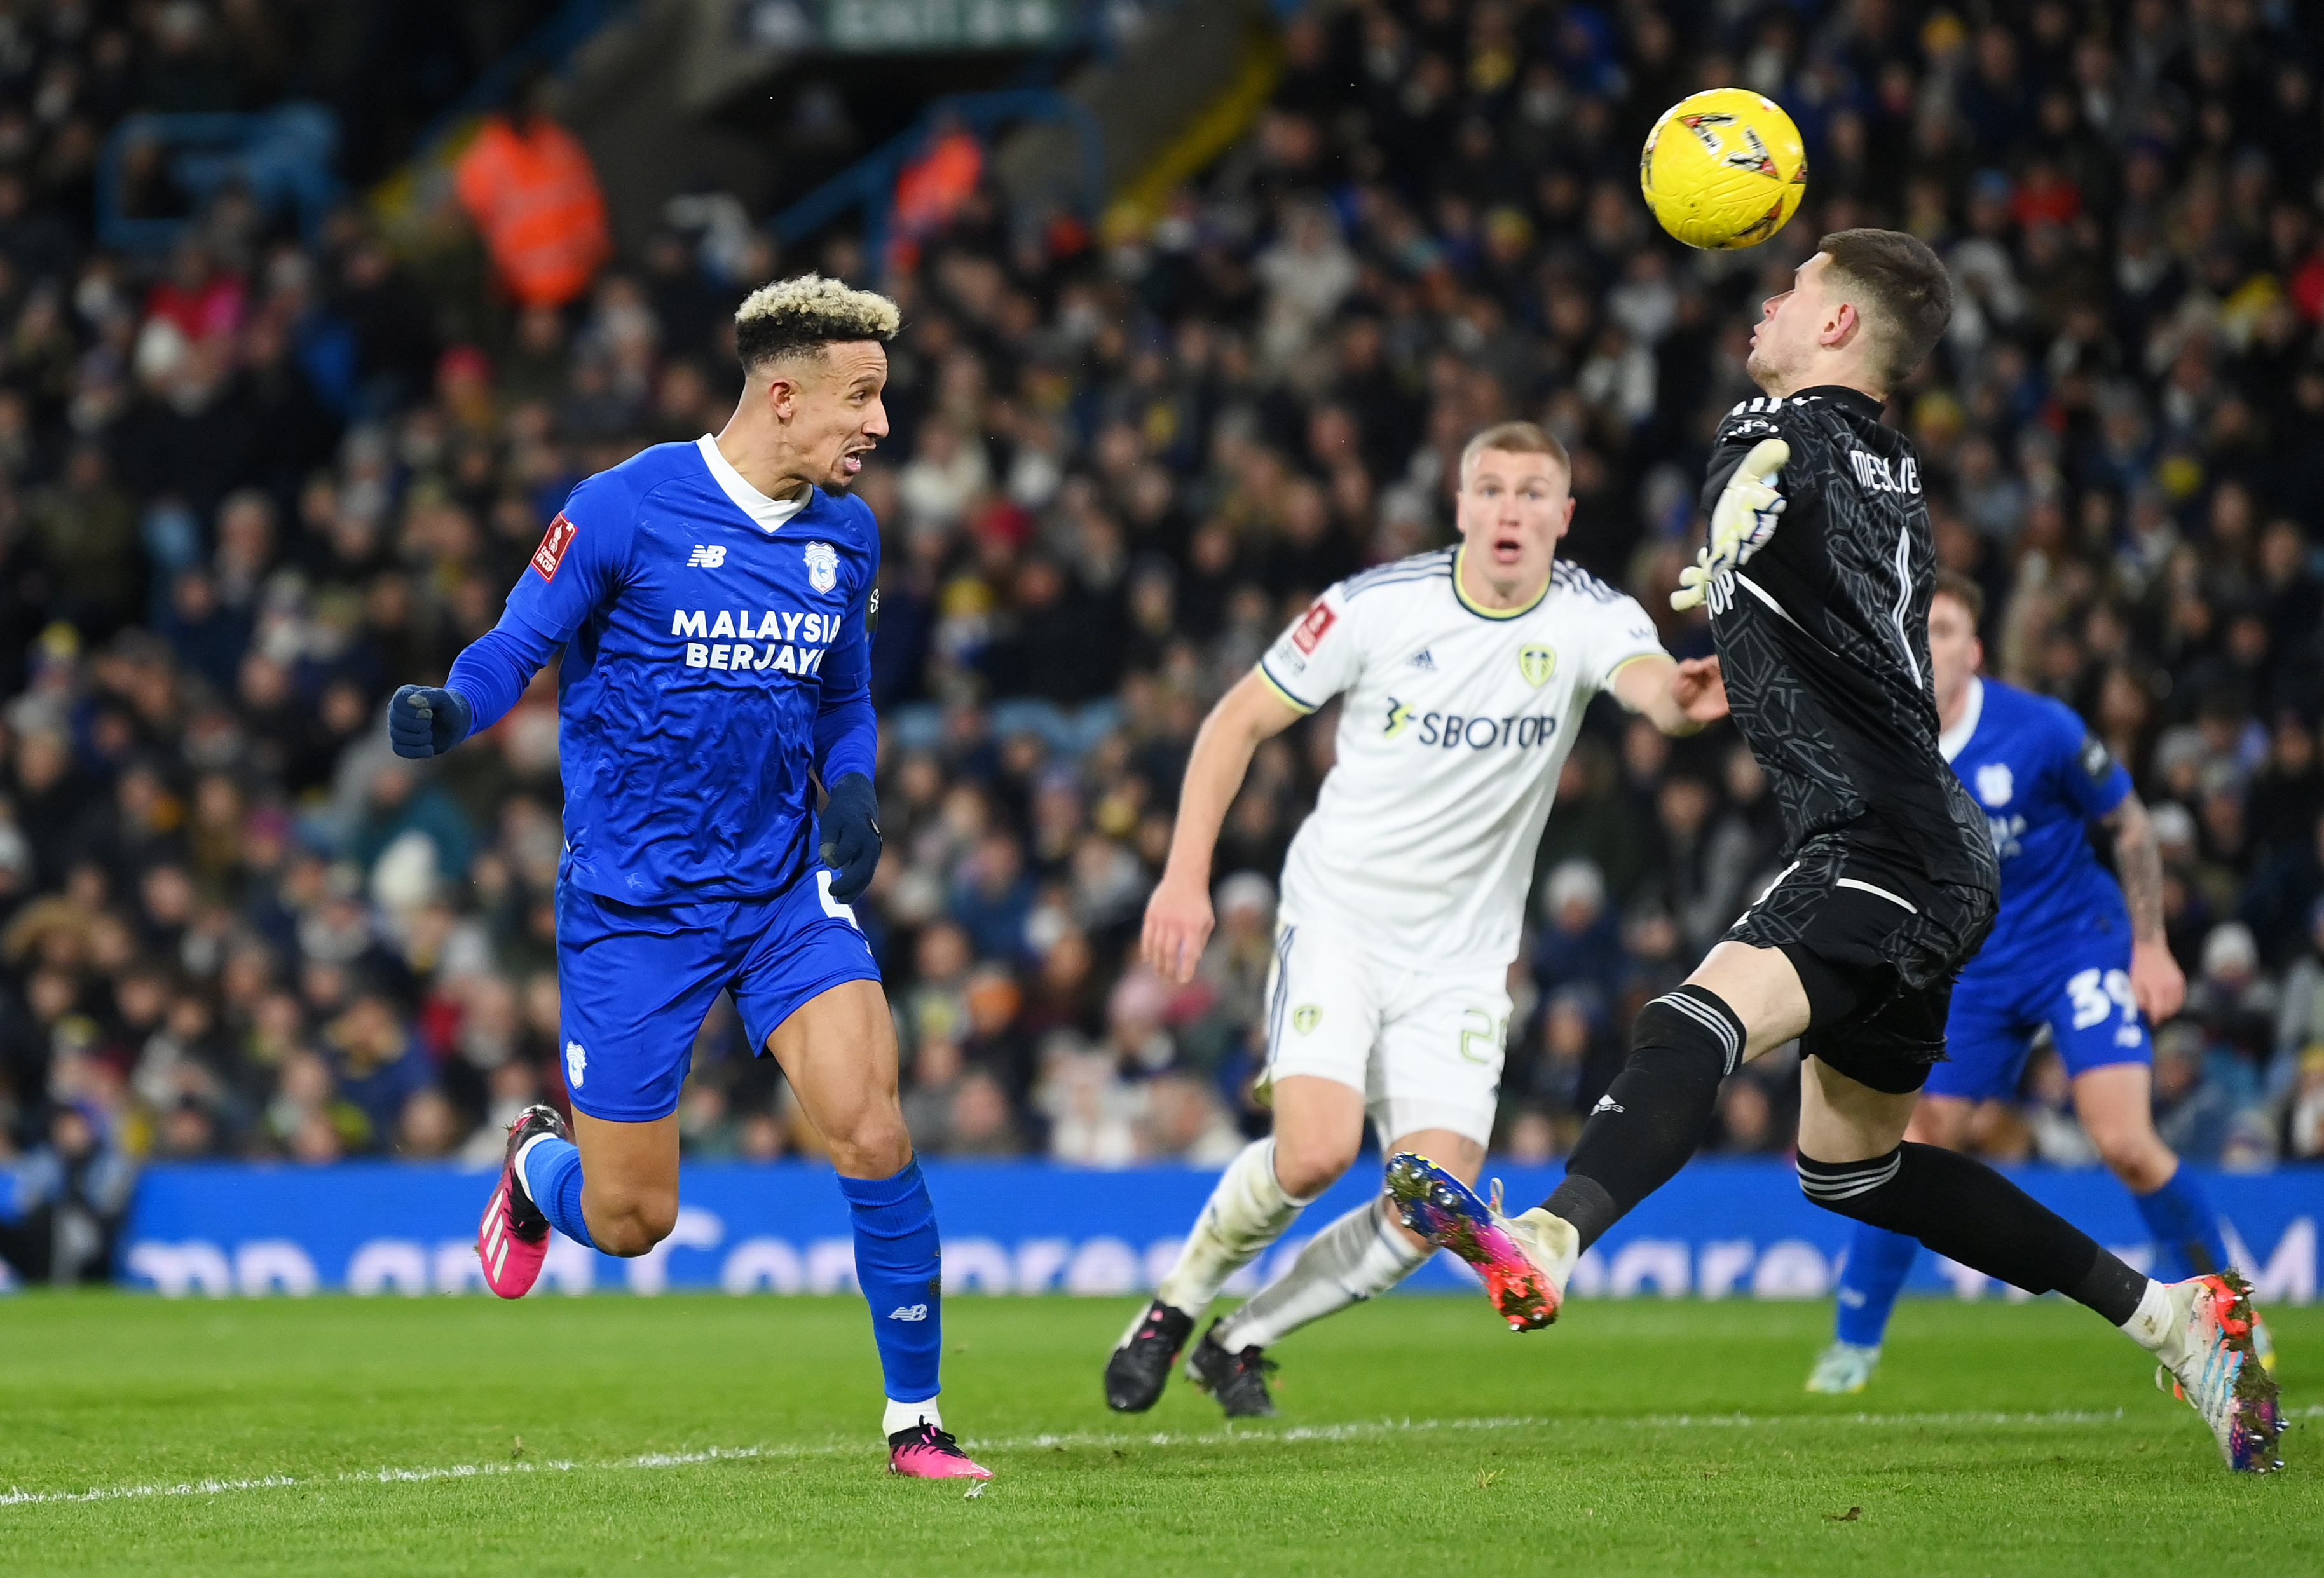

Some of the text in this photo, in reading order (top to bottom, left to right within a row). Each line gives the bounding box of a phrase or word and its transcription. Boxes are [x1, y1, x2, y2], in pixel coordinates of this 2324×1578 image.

[535, 552, 554, 573] FA CUP
[671, 609, 840, 643] MALAYSIA
[1419, 712, 1557, 750] SBOTOP
[2066, 966, 2138, 1031] 39
